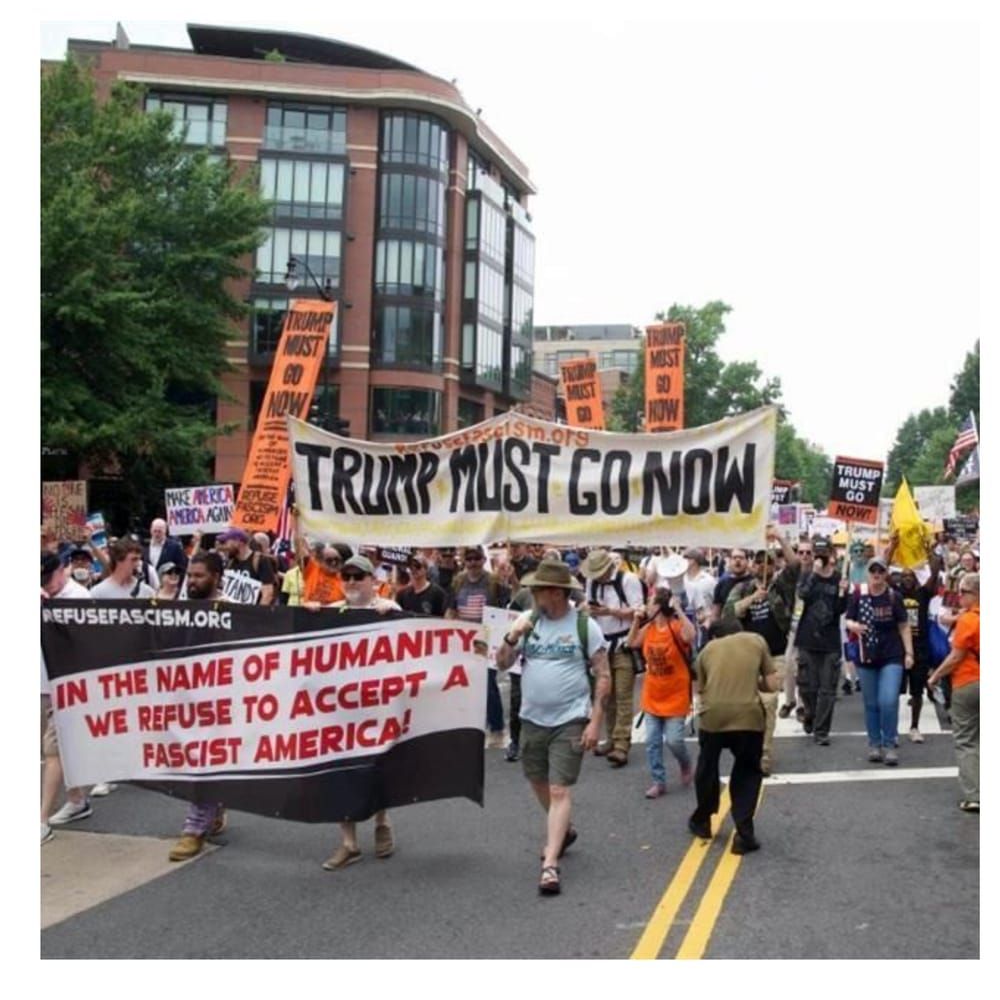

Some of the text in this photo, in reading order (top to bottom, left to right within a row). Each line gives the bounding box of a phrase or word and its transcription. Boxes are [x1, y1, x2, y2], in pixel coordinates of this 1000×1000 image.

[286, 310, 334, 332] TRUMP
[282, 334, 324, 358] MUST
[650, 348, 681, 368] MUST
[282, 363, 304, 386] GO
[656, 374, 671, 394] GO
[566, 381, 596, 402] MUST
[267, 391, 309, 420] NOW
[648, 398, 680, 423] NOW
[294, 441, 440, 515] TRUMP
[448, 436, 560, 514] MUST
[569, 448, 632, 515] GO
[642, 442, 757, 516] NOW
[836, 463, 881, 481] TRUMP
[166, 486, 232, 506] MAKE AMERICA
[838, 478, 876, 492] MUST
[845, 490, 865, 502] GO
[168, 506, 204, 525] AMERICA
[42, 607, 232, 630] REFUSEFASCISM.ORG
[56, 627, 478, 711] IN THE NAME OF HUMANITY
[84, 664, 470, 739] WE REFUSE TO ACCEPT A
[142, 709, 412, 770] FASCIST AMERICA!
